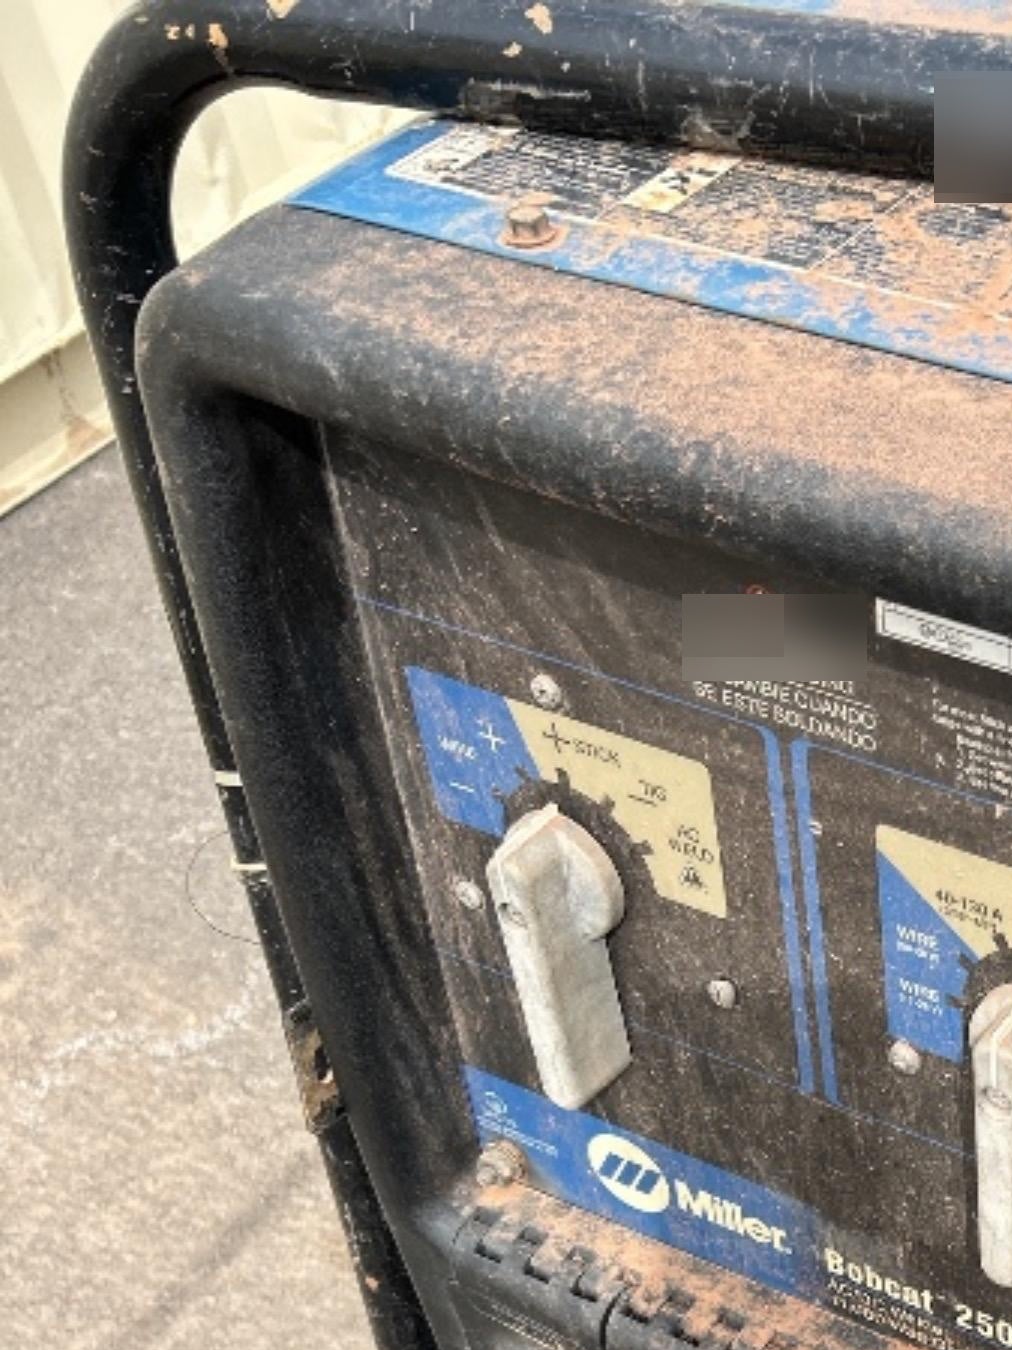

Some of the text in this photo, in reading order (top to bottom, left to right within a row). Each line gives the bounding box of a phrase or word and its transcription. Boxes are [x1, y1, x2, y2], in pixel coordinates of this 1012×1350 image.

[638, 779, 668, 801] TIG
[674, 1178, 788, 1254] Miller
[824, 1247, 935, 1314] Bobcat
